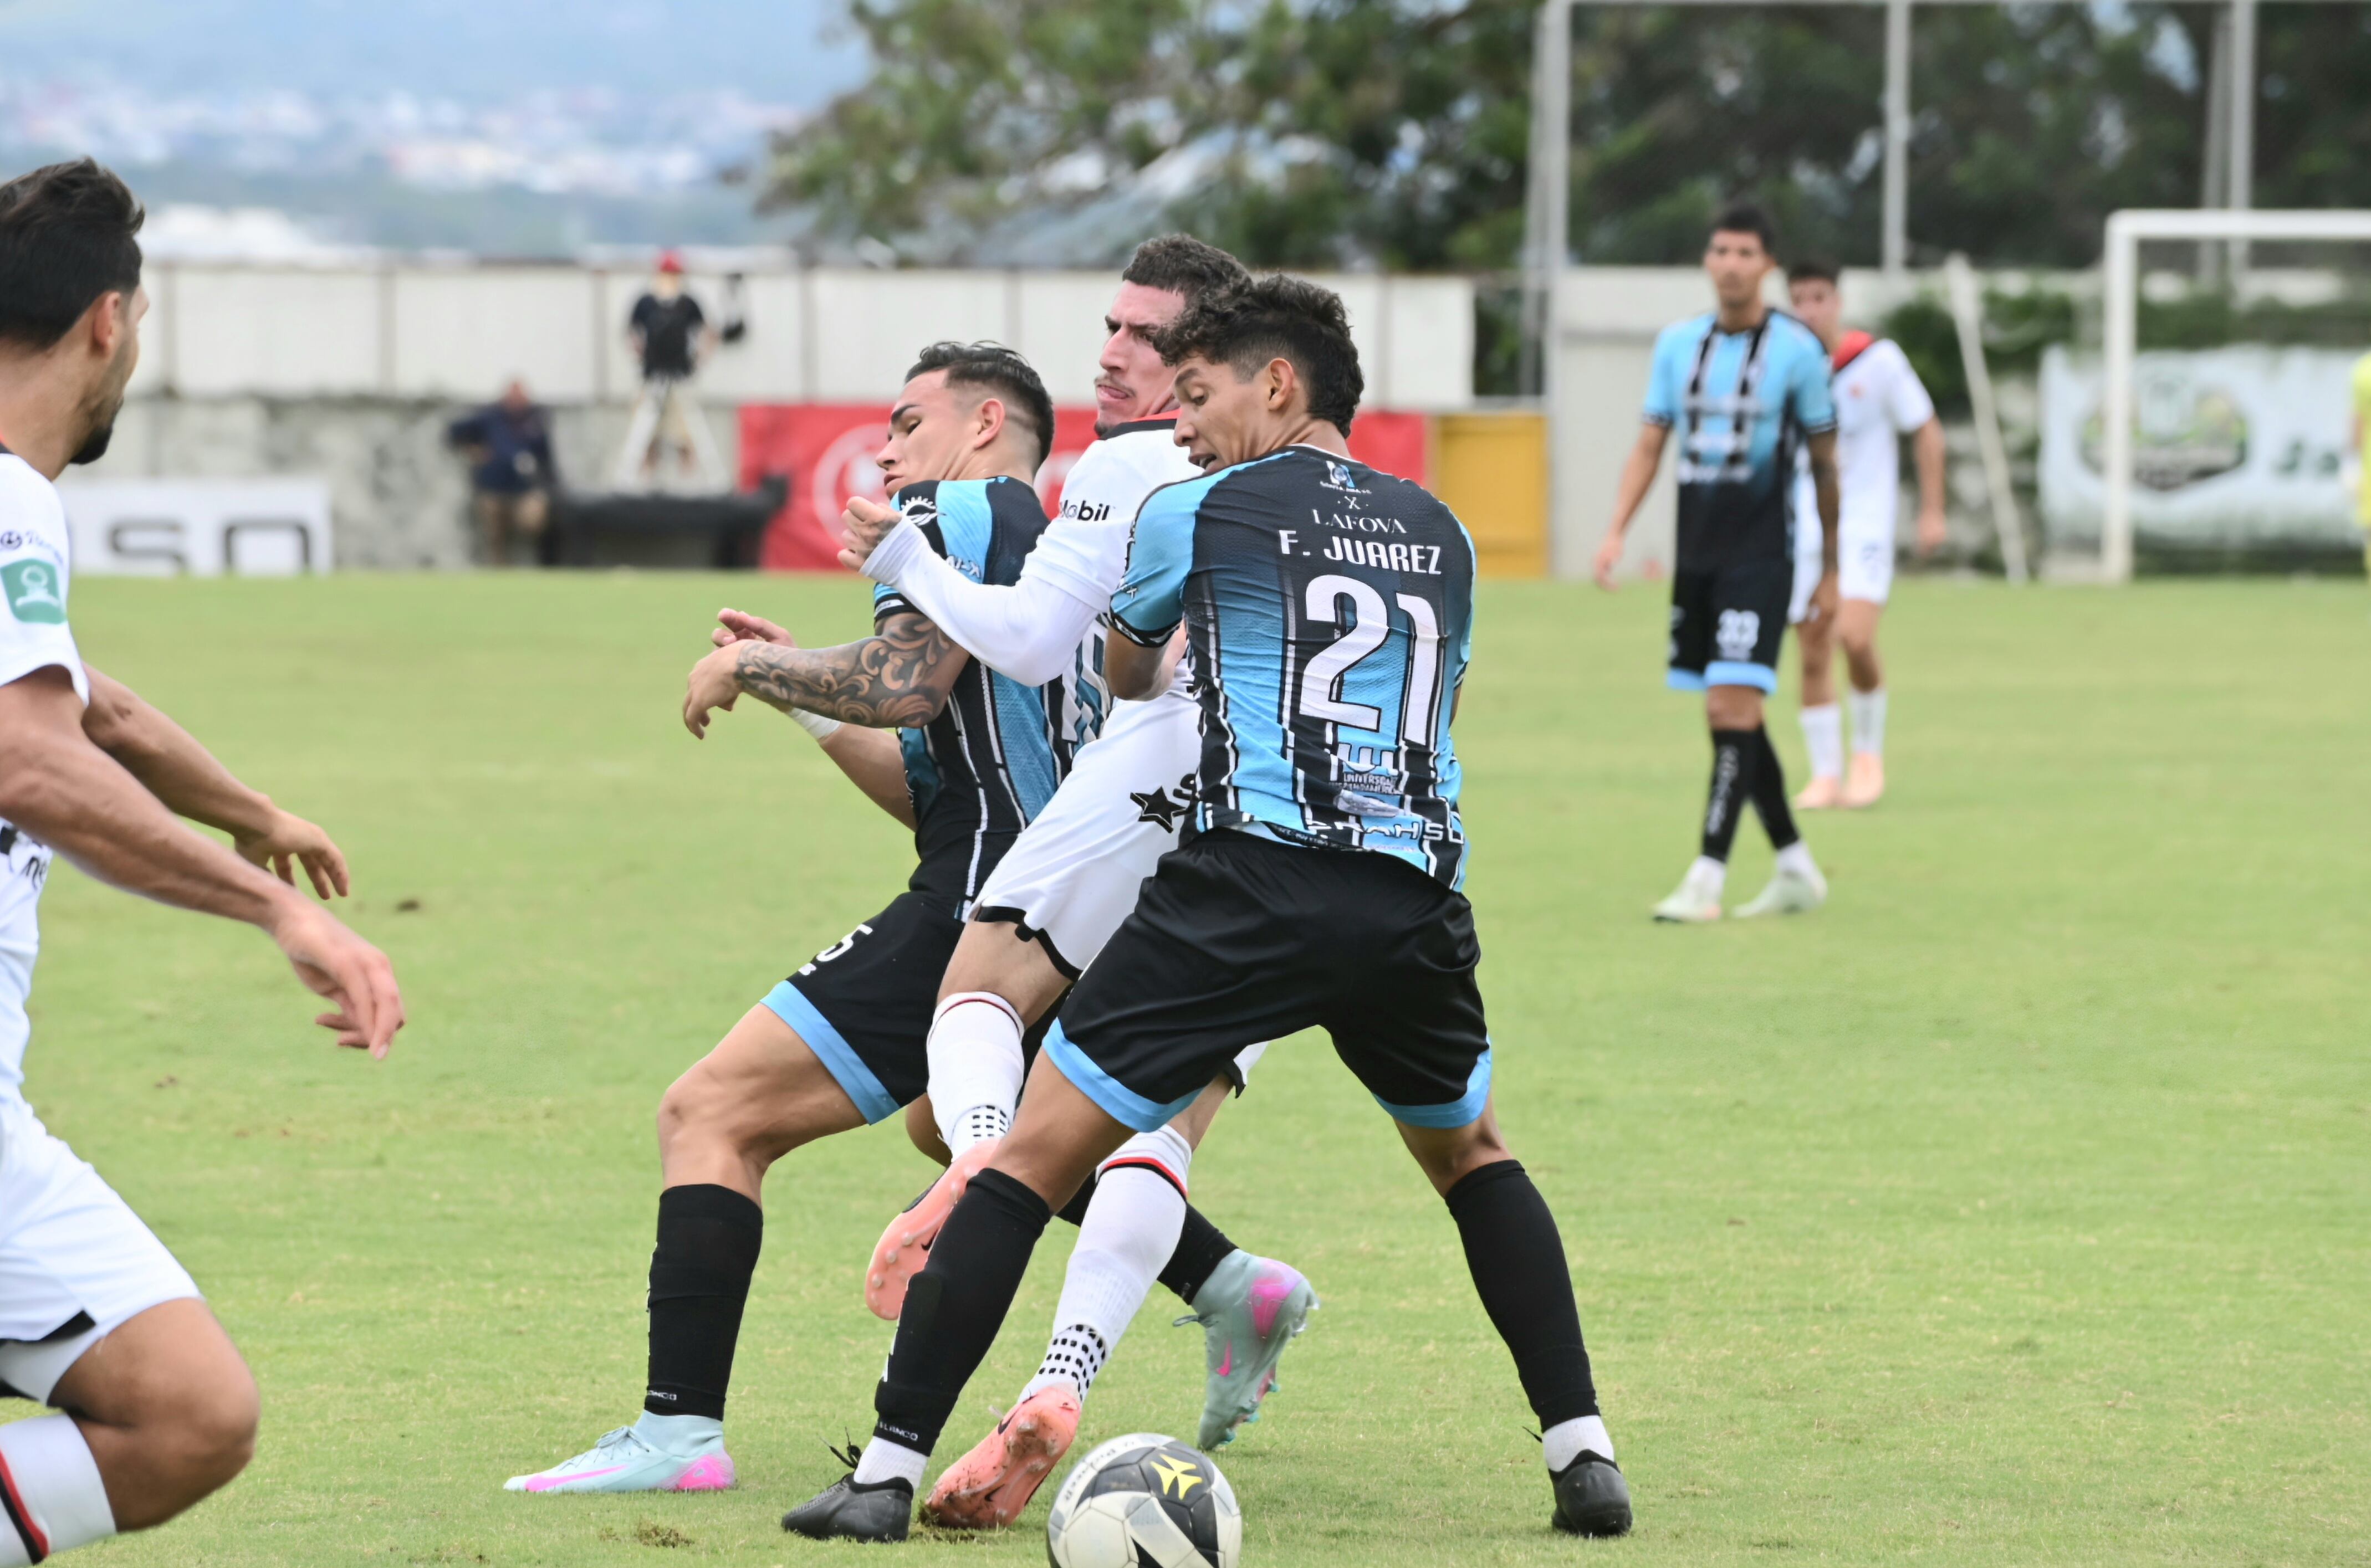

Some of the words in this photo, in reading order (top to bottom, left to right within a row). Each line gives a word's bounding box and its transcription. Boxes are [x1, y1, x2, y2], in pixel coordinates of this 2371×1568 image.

[1279, 529, 1311, 556] F.
[1323, 535, 1442, 575] JUAREZ
[1299, 573, 1440, 747] 21
